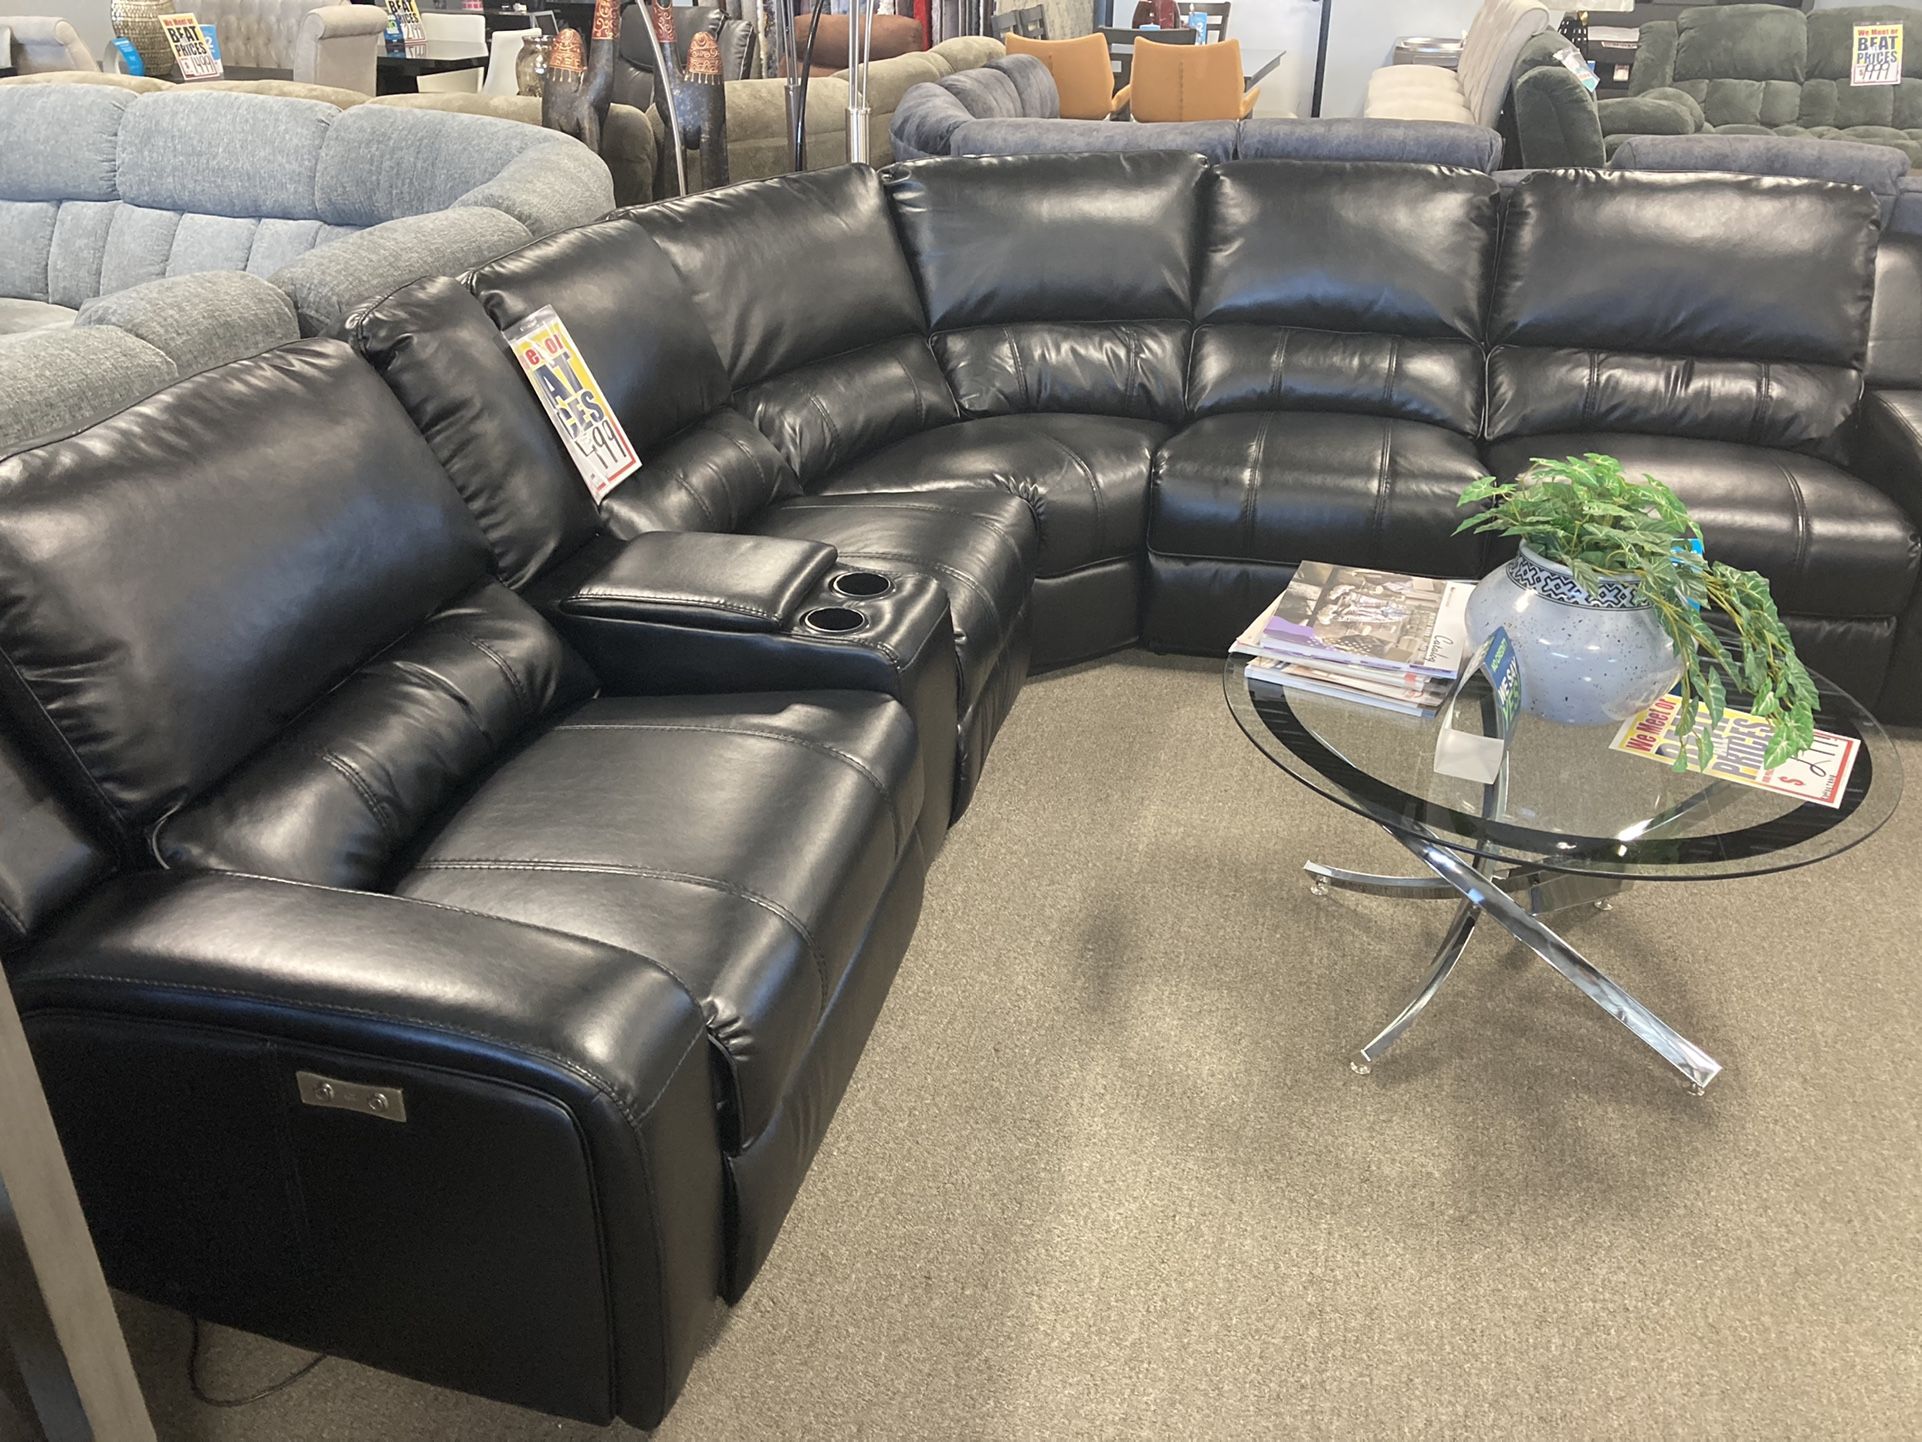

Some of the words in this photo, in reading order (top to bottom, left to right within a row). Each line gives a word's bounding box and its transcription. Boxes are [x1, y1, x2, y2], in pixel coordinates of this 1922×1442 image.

[167, 26, 199, 43] BEAT
[1871, 28, 1889, 36] Meet
[174, 42, 207, 57] PRICES
[1857, 35, 1898, 52] BEAT
[1856, 50, 1897, 65] PRICES
[1655, 698, 1677, 711] or
[1636, 708, 1671, 736] Meet
[1625, 733, 1657, 752] We
[1712, 718, 1774, 780] PRICES
